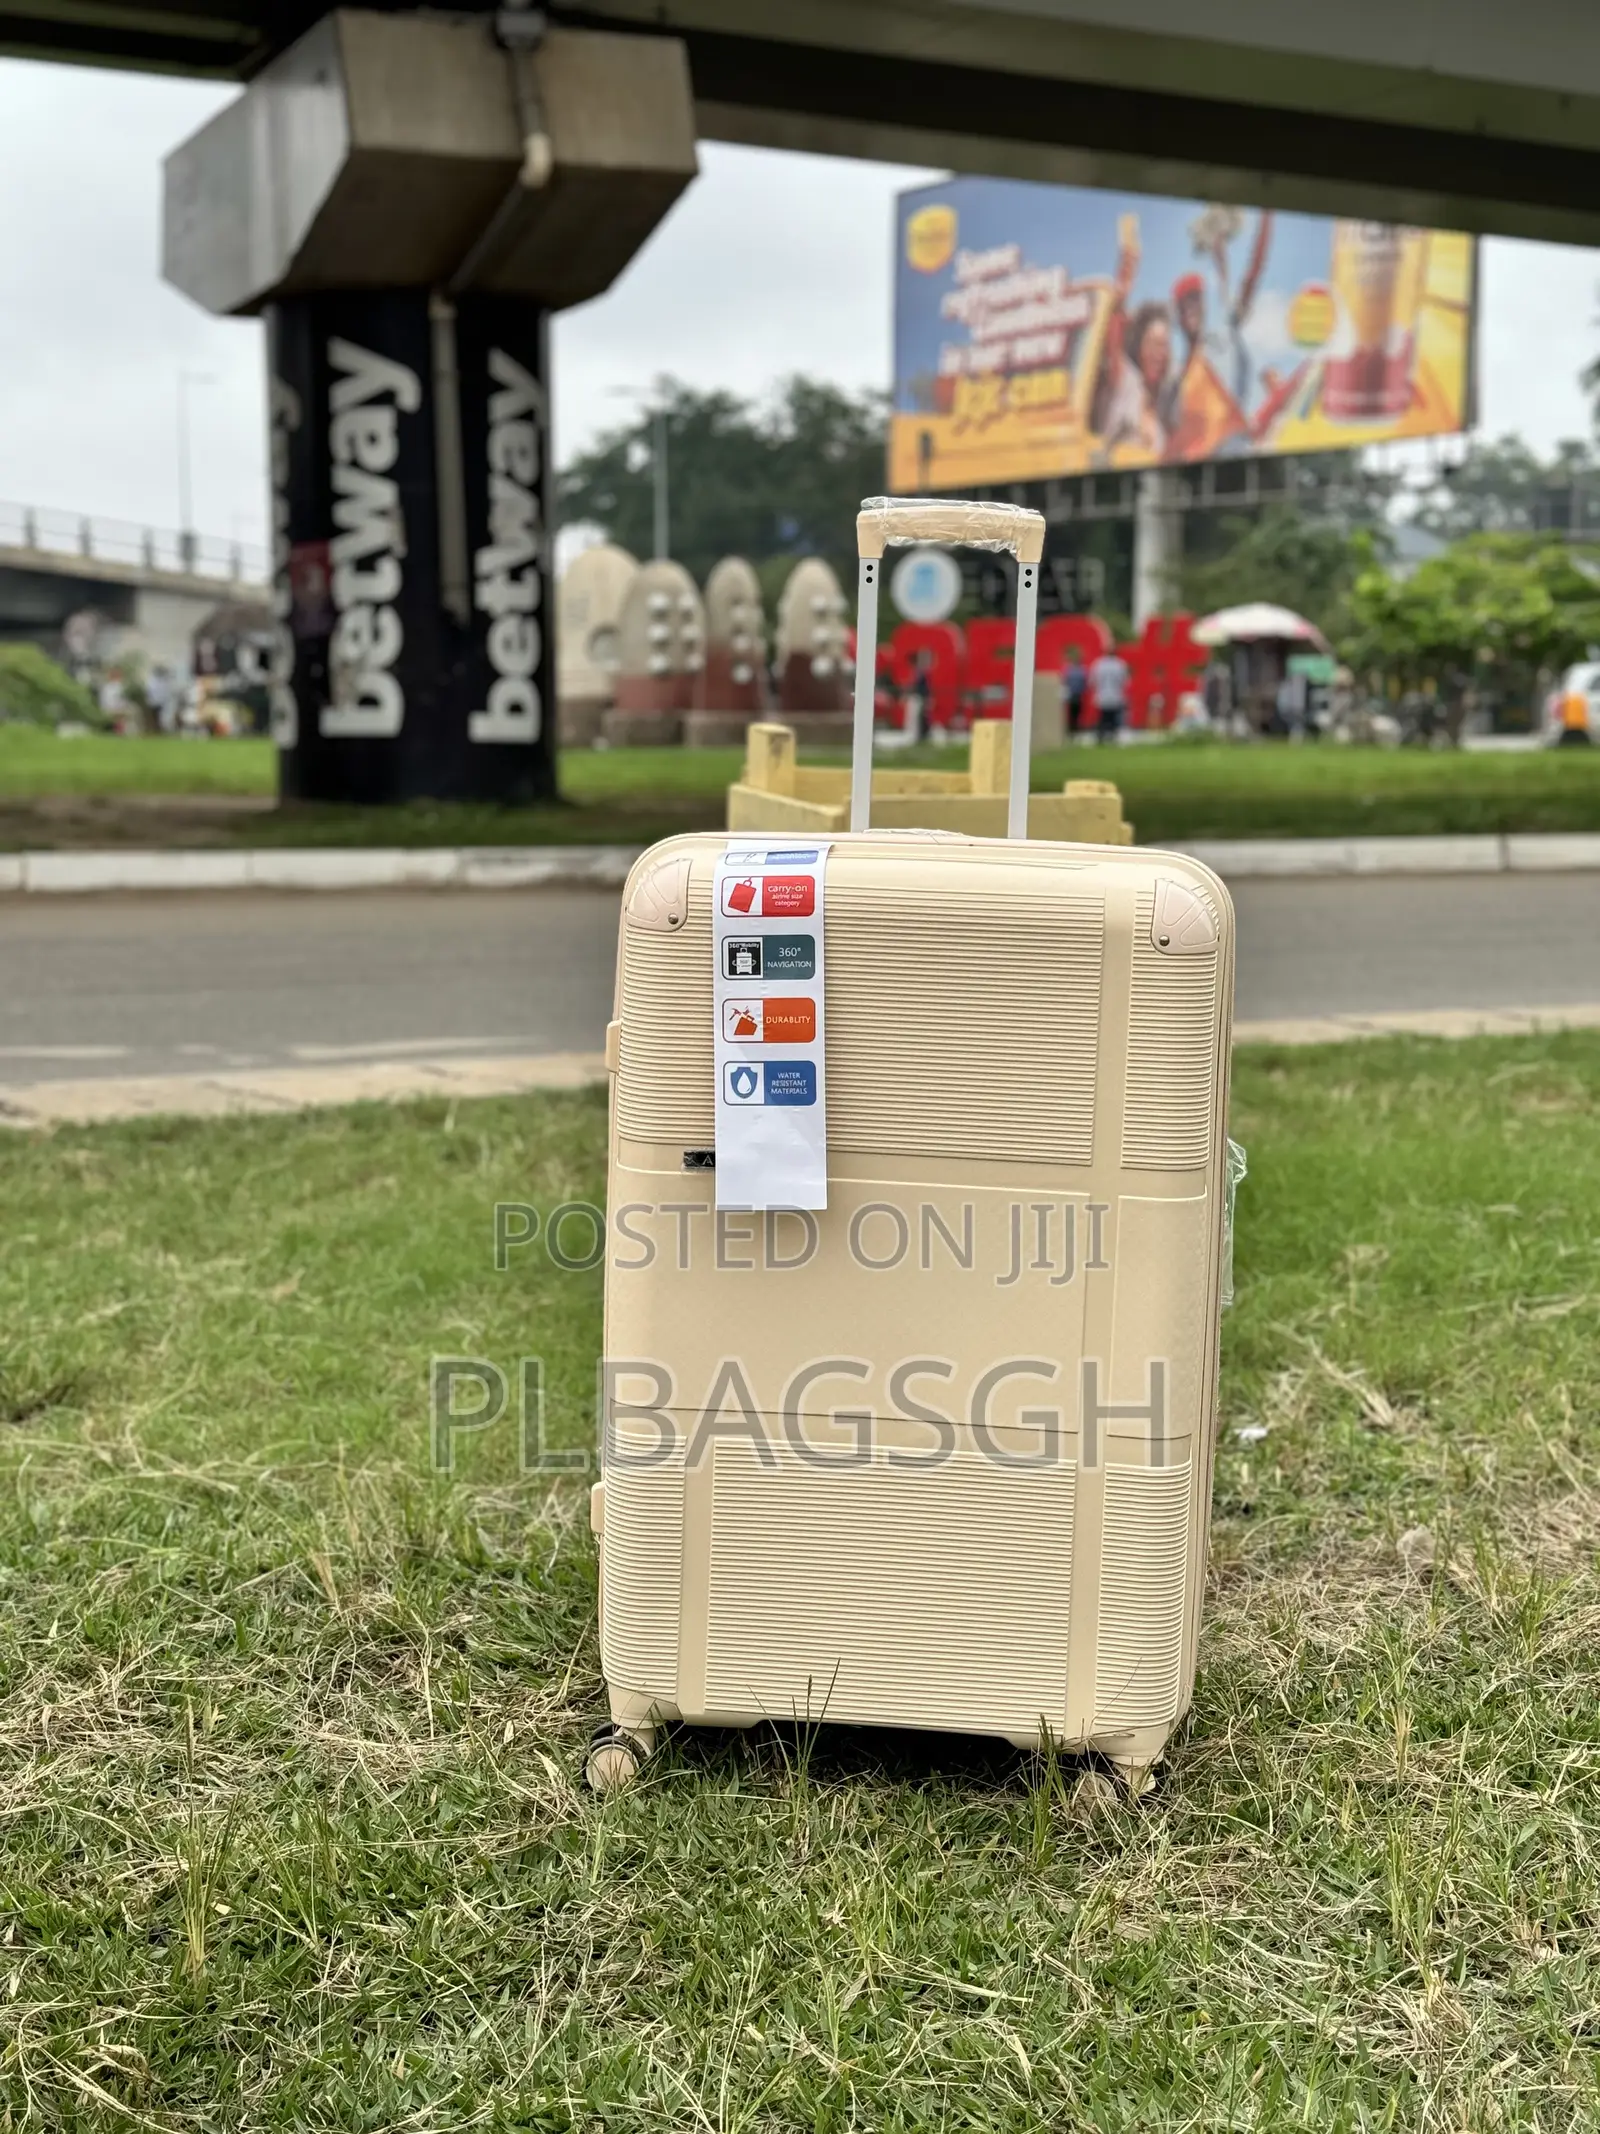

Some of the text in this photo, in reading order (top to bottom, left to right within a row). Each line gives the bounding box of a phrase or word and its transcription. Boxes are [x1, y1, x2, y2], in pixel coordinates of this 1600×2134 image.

[319, 336, 421, 738] betway
[467, 347, 546, 743] betway
[767, 884, 808, 894] carry-on
[774, 900, 800, 908] category
[778, 947, 802, 957] 360°
